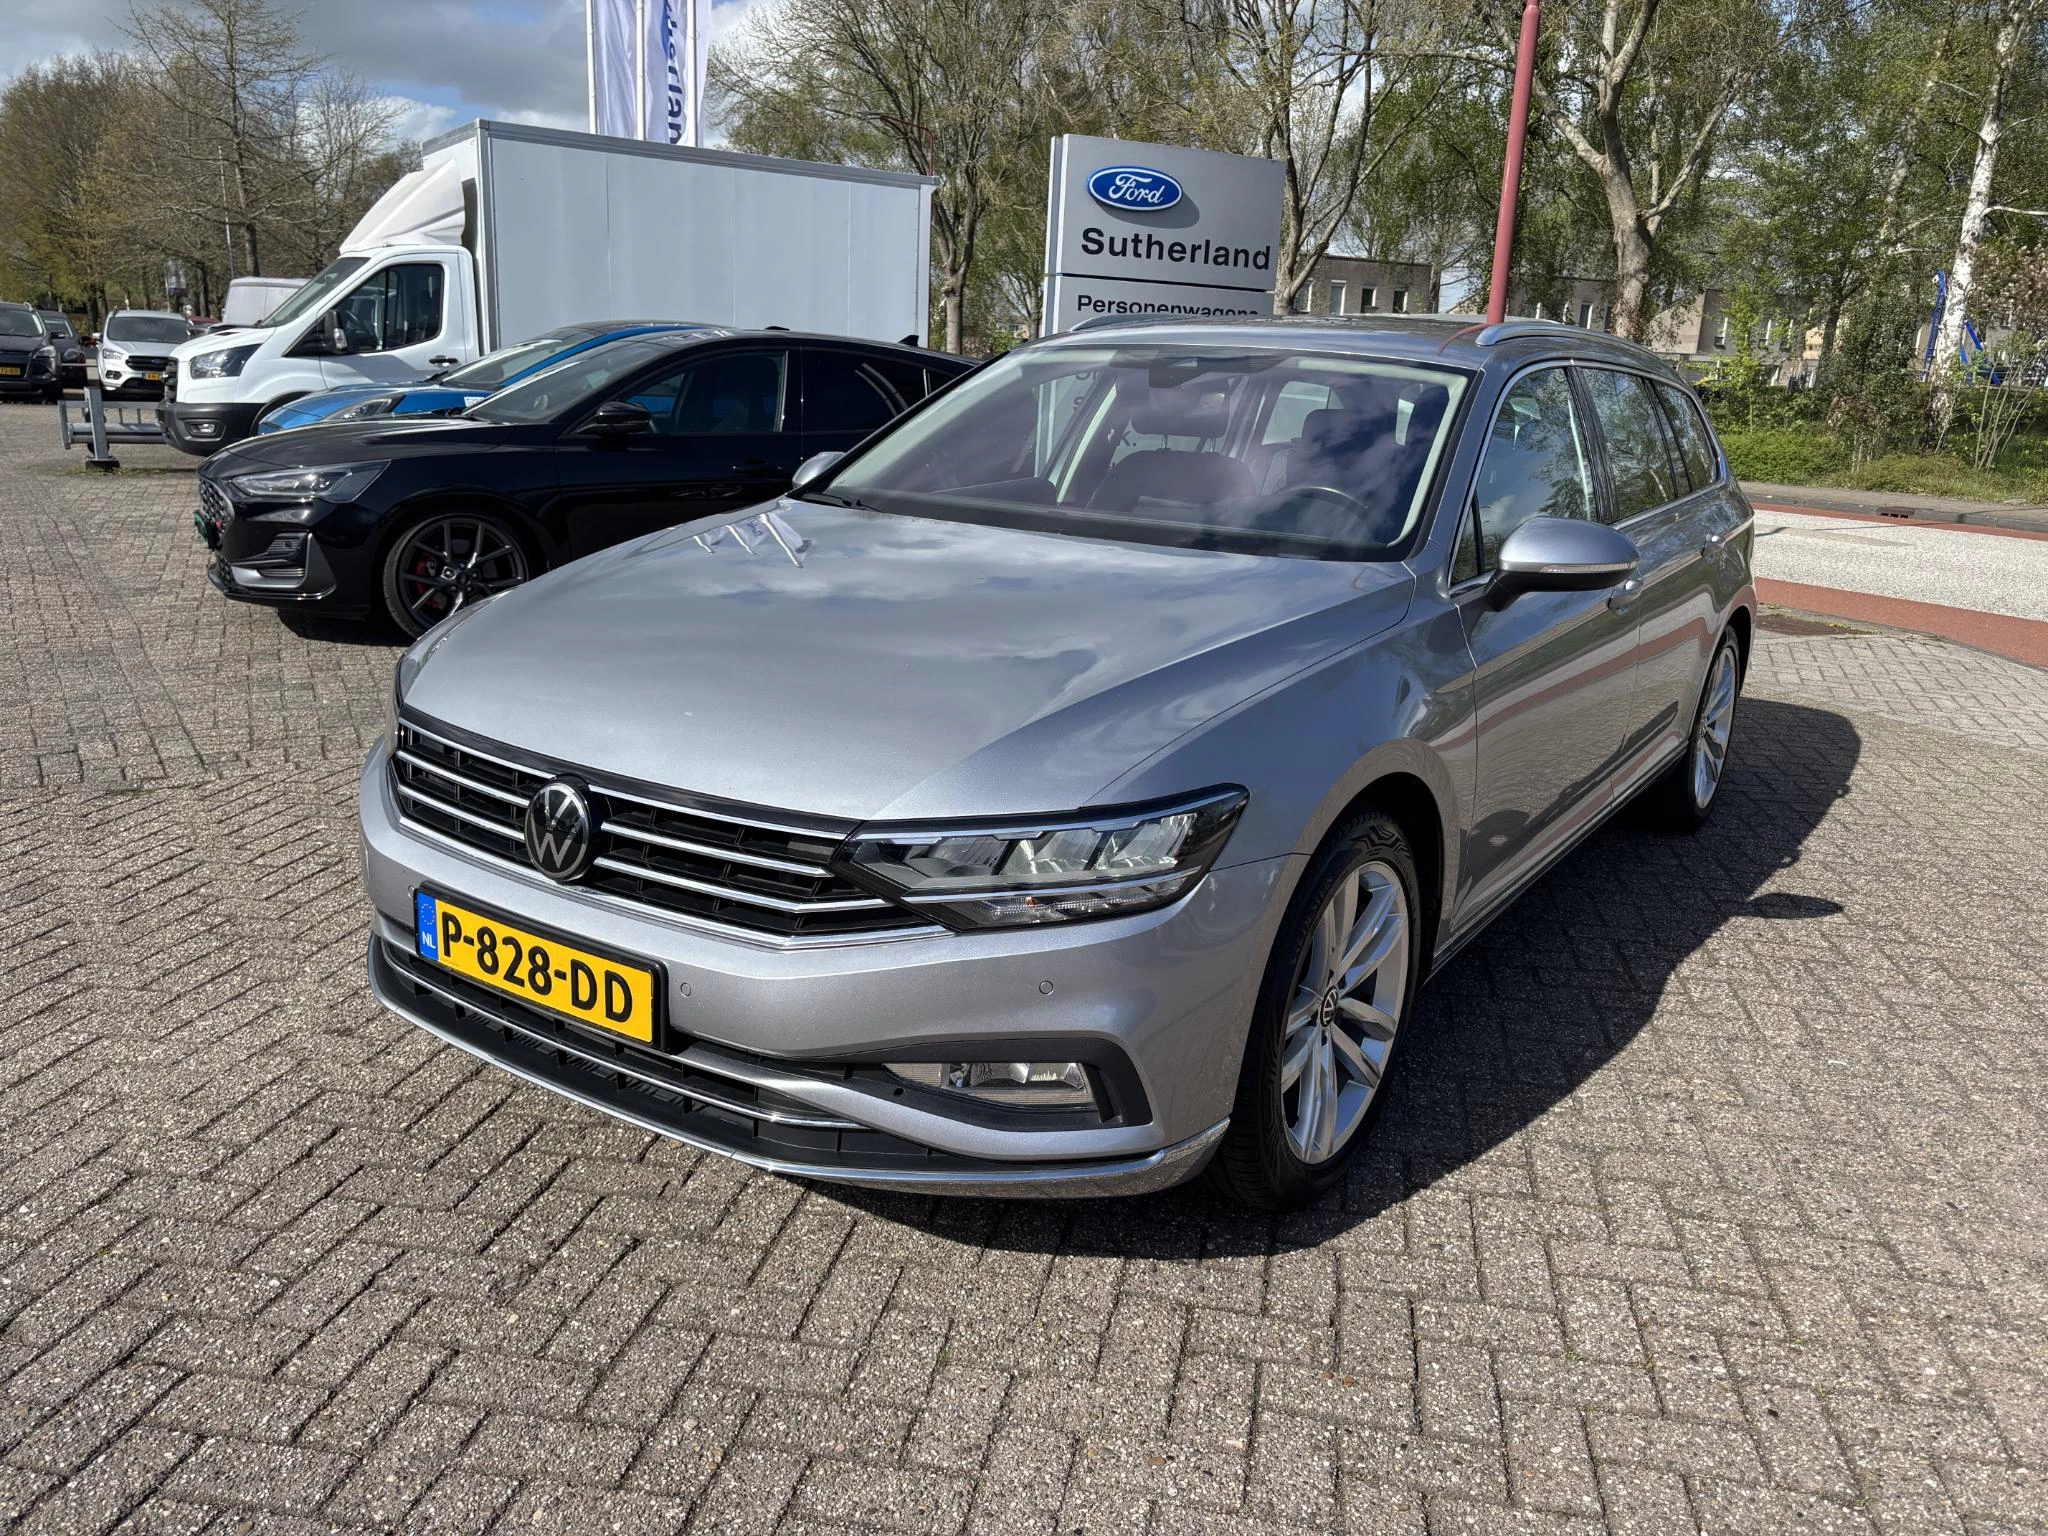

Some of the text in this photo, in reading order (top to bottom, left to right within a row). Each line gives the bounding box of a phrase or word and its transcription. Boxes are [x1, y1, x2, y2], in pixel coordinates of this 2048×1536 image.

[1108, 173, 1165, 204] Ford
[1081, 227, 1271, 270] Sutherland
[1077, 294, 1259, 317] Personenwa
[422, 931, 436, 949] NL
[442, 911, 633, 1023] P-828-DD
